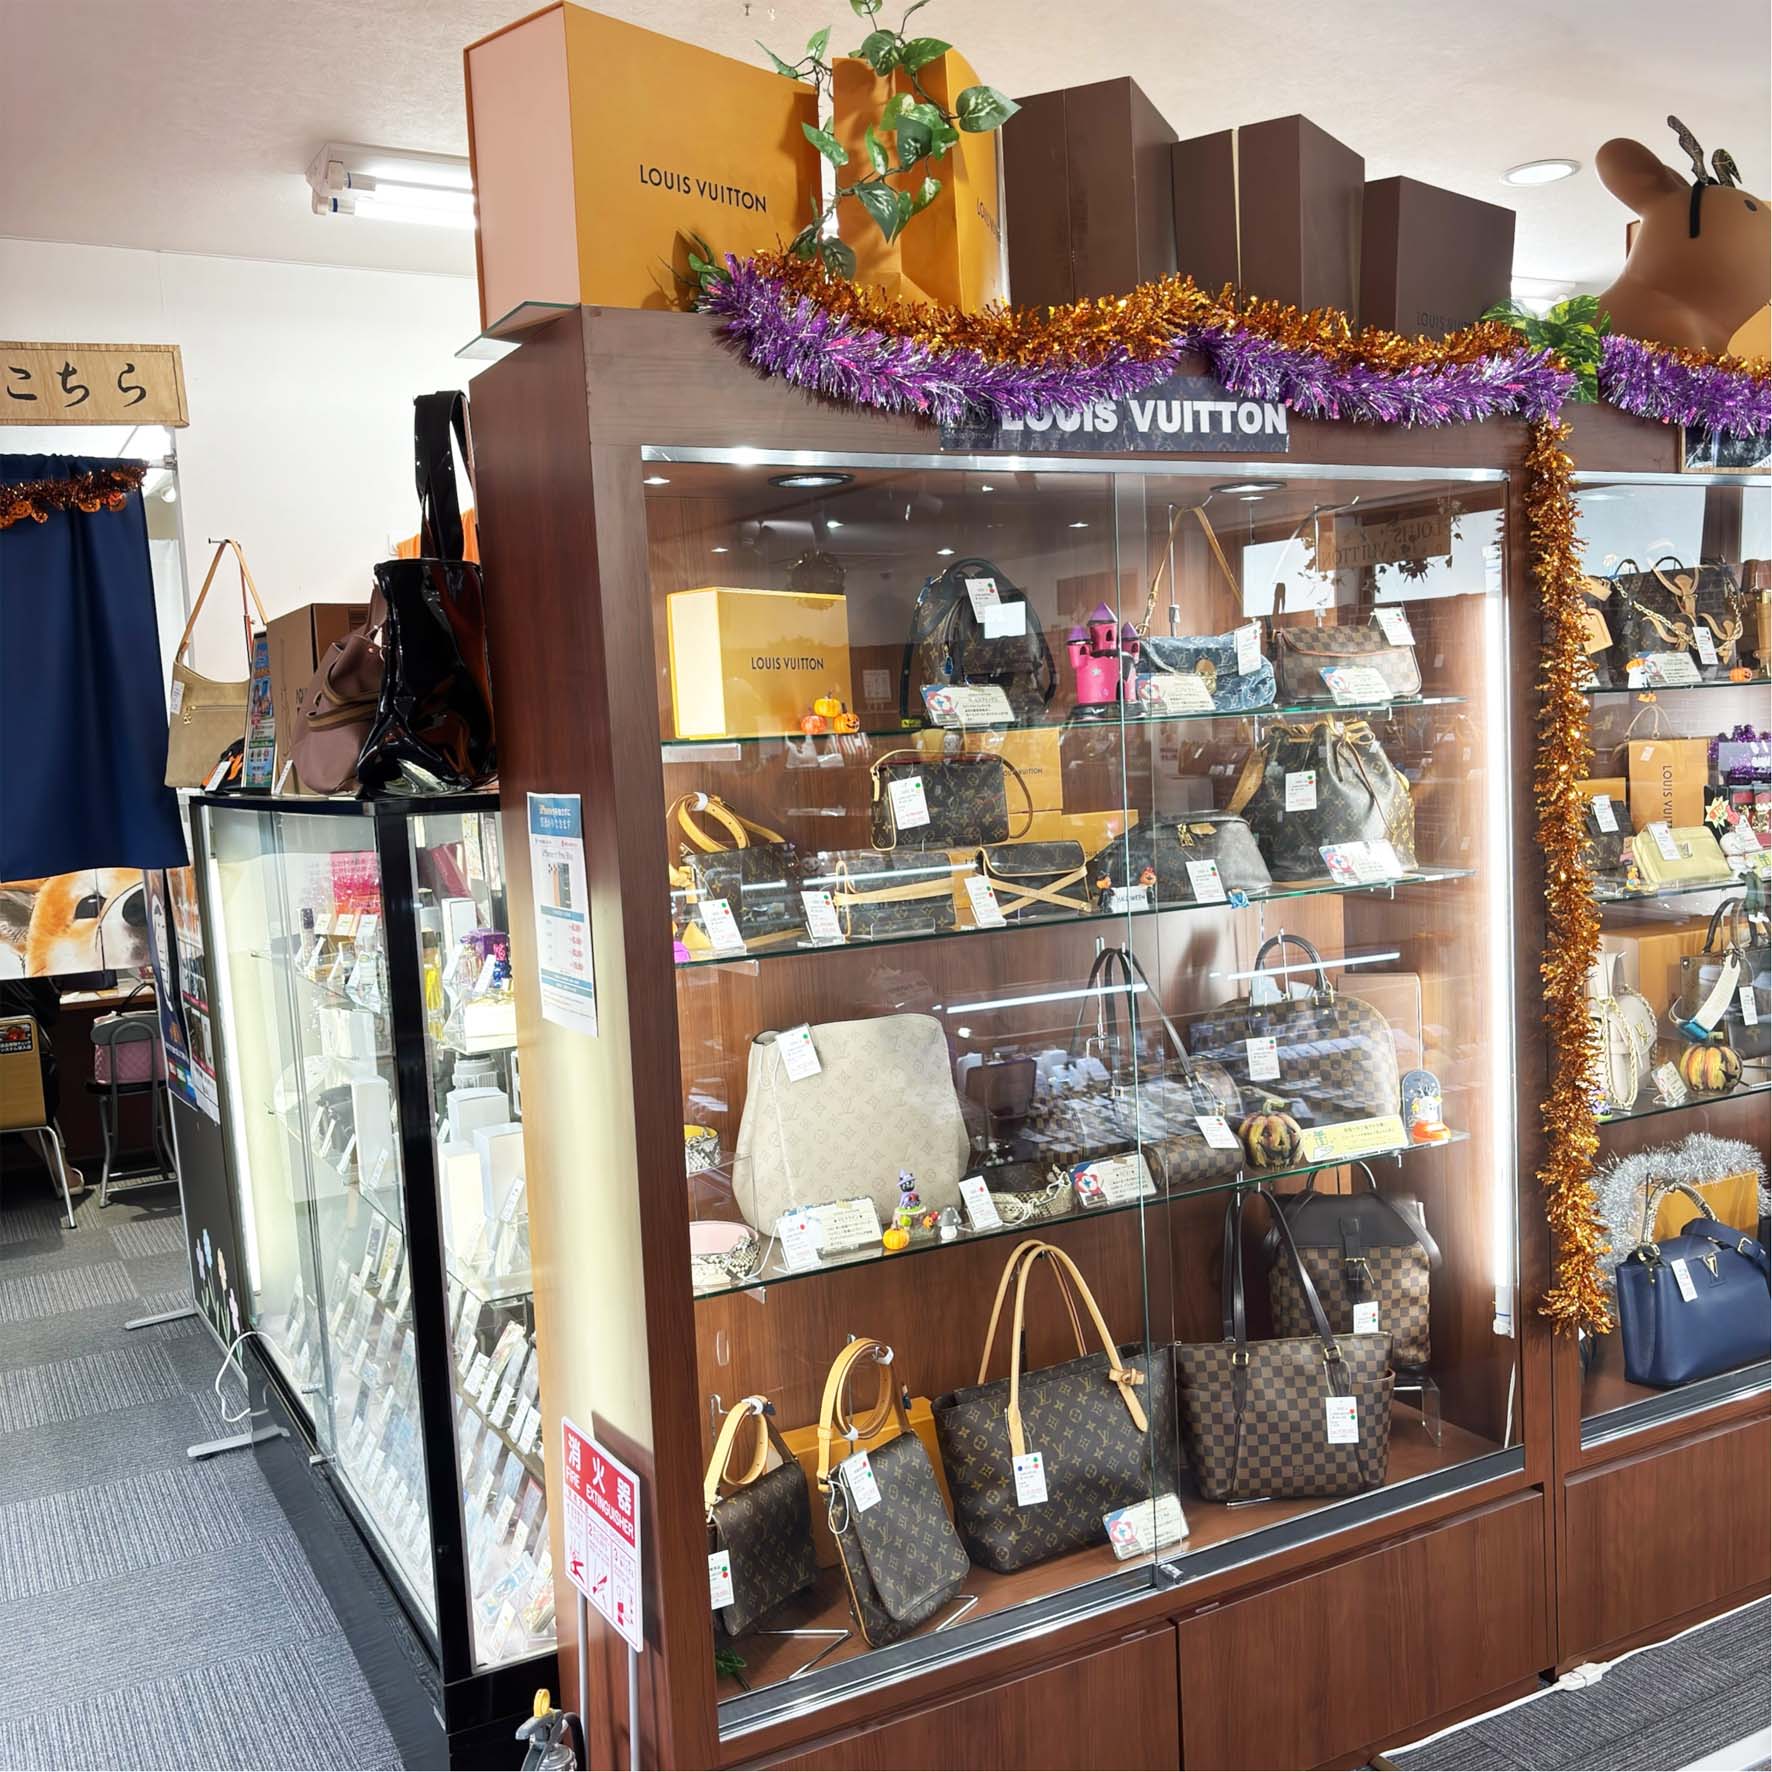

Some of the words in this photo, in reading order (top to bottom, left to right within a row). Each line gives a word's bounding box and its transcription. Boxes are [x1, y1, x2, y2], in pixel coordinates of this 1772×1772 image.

[640, 164, 691, 194] LOUIS
[696, 179, 767, 213] VUITTON
[7, 361, 146, 408] こちら
[1130, 400, 1287, 435] VUITTON
[751, 656, 781, 670] LOUIS
[784, 656, 825, 670] VUITTON
[1662, 765, 1673, 798] LOUIS
[568, 1432, 633, 1516] 消火器
[566, 1465, 581, 1490] FIRE
[586, 1483, 635, 1540] EXTINGUISHER
